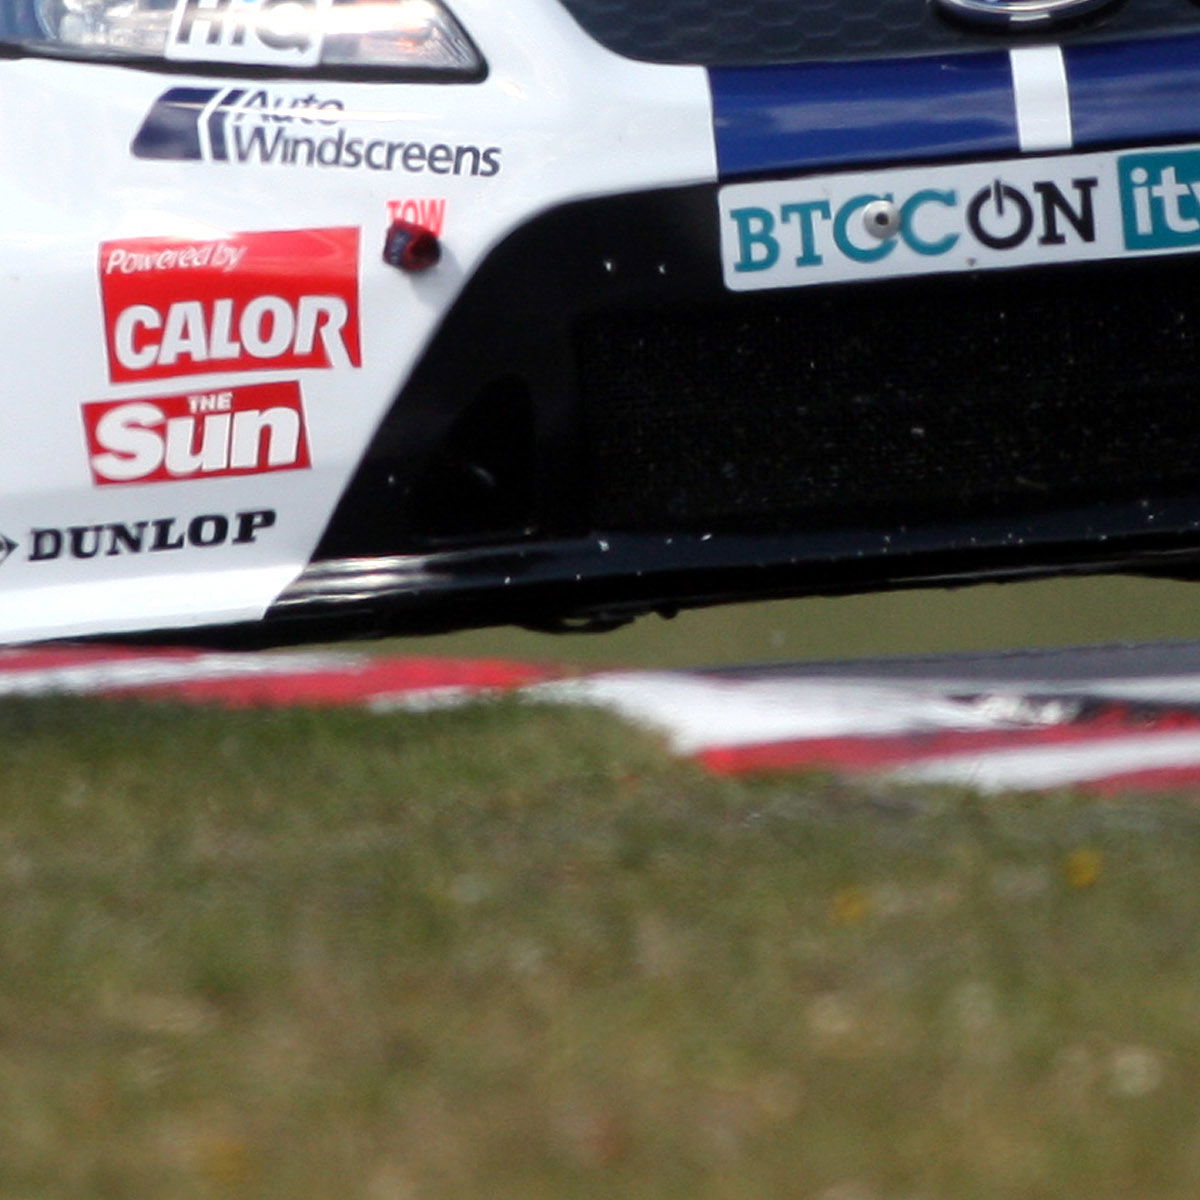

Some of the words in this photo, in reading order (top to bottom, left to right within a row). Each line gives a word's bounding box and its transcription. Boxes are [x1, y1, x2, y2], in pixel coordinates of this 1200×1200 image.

[232, 90, 345, 125] Auto
[233, 124, 502, 178] Windscreens
[387, 199, 446, 237] TOW
[106, 243, 211, 275] Powered
[213, 242, 246, 272] by
[114, 294, 354, 371] CALOR
[189, 393, 234, 413] THE
[92, 402, 302, 482] Sun
[28, 509, 277, 561] DUNLOP
